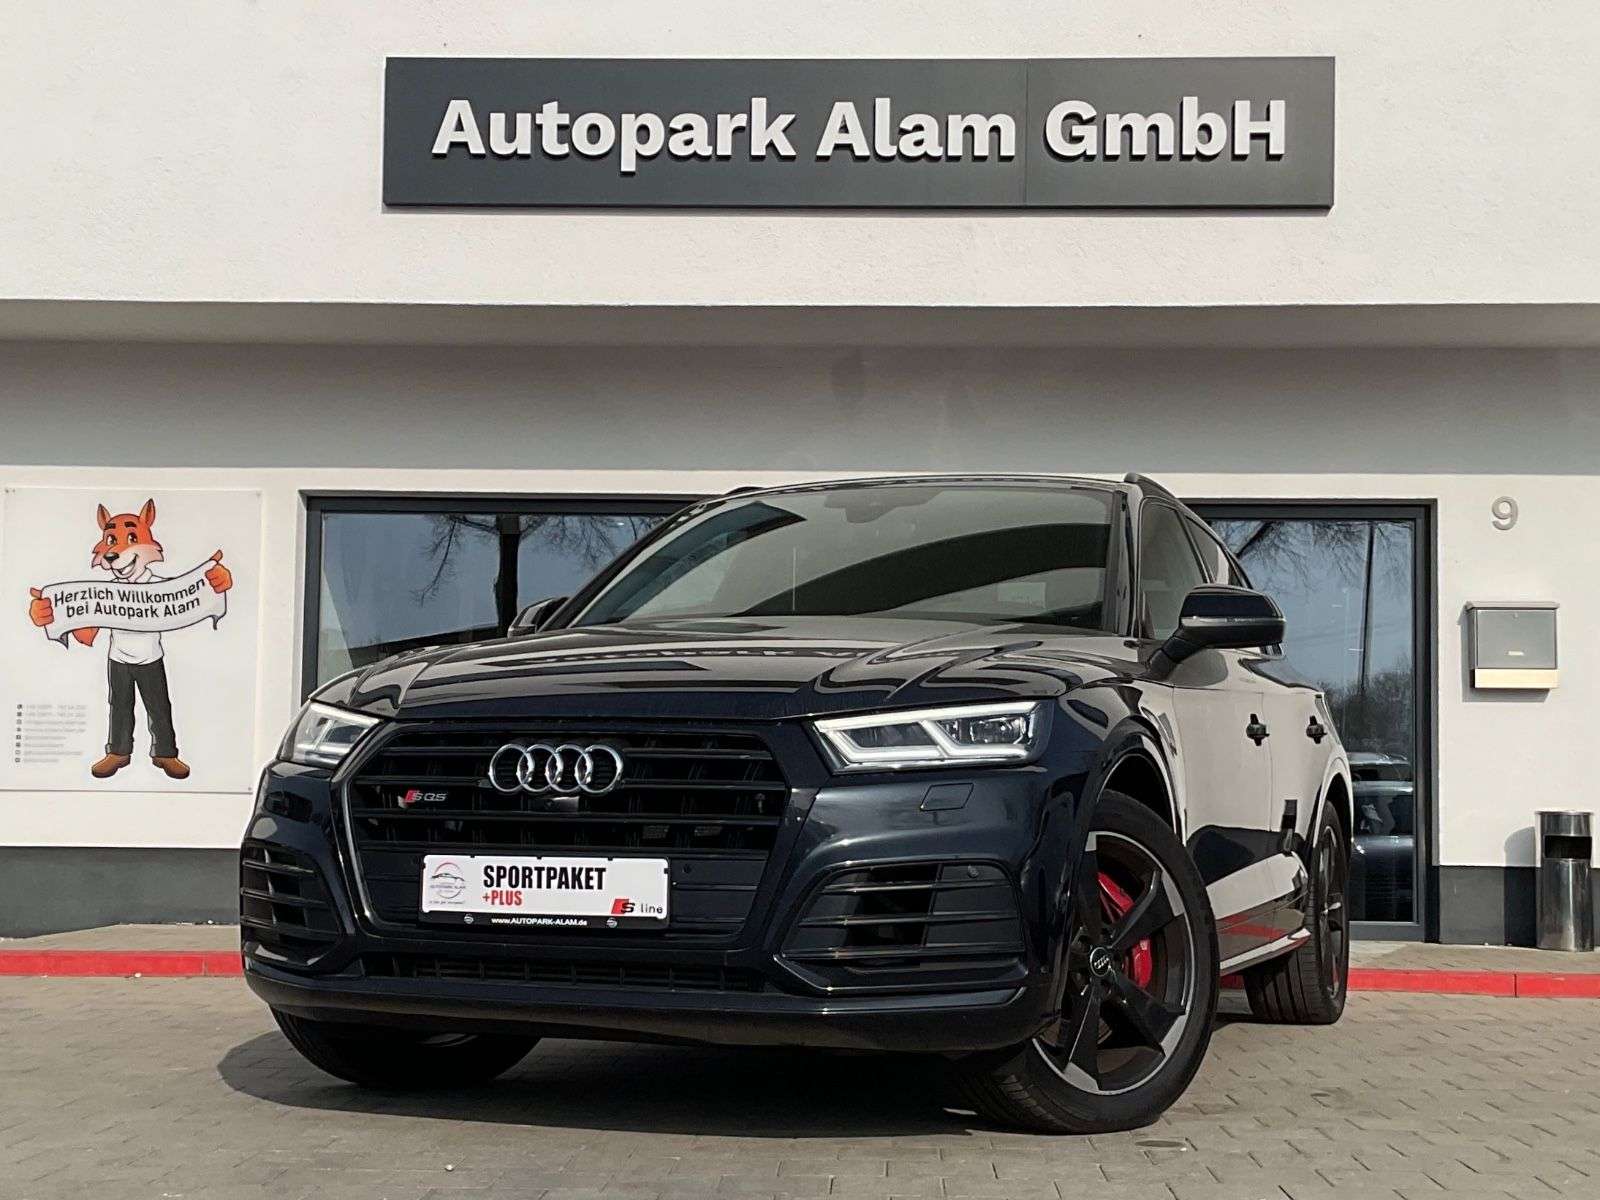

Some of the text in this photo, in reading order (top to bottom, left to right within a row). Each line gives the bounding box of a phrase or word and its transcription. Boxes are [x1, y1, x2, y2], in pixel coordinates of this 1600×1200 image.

[431, 96, 1287, 173] Autopark Alam GmbH
[1492, 496, 1518, 531] 9
[54, 578, 205, 607] Herzlich Willkommen
[66, 597, 201, 619] bei Autopark Alam
[408, 789, 448, 802] SQ5
[483, 865, 607, 890] SPORTPAKET
[482, 889, 523, 906] +PLUS
[615, 900, 663, 914] S line
[491, 917, 588, 926] www.AUTOPARK-ALAM.de
